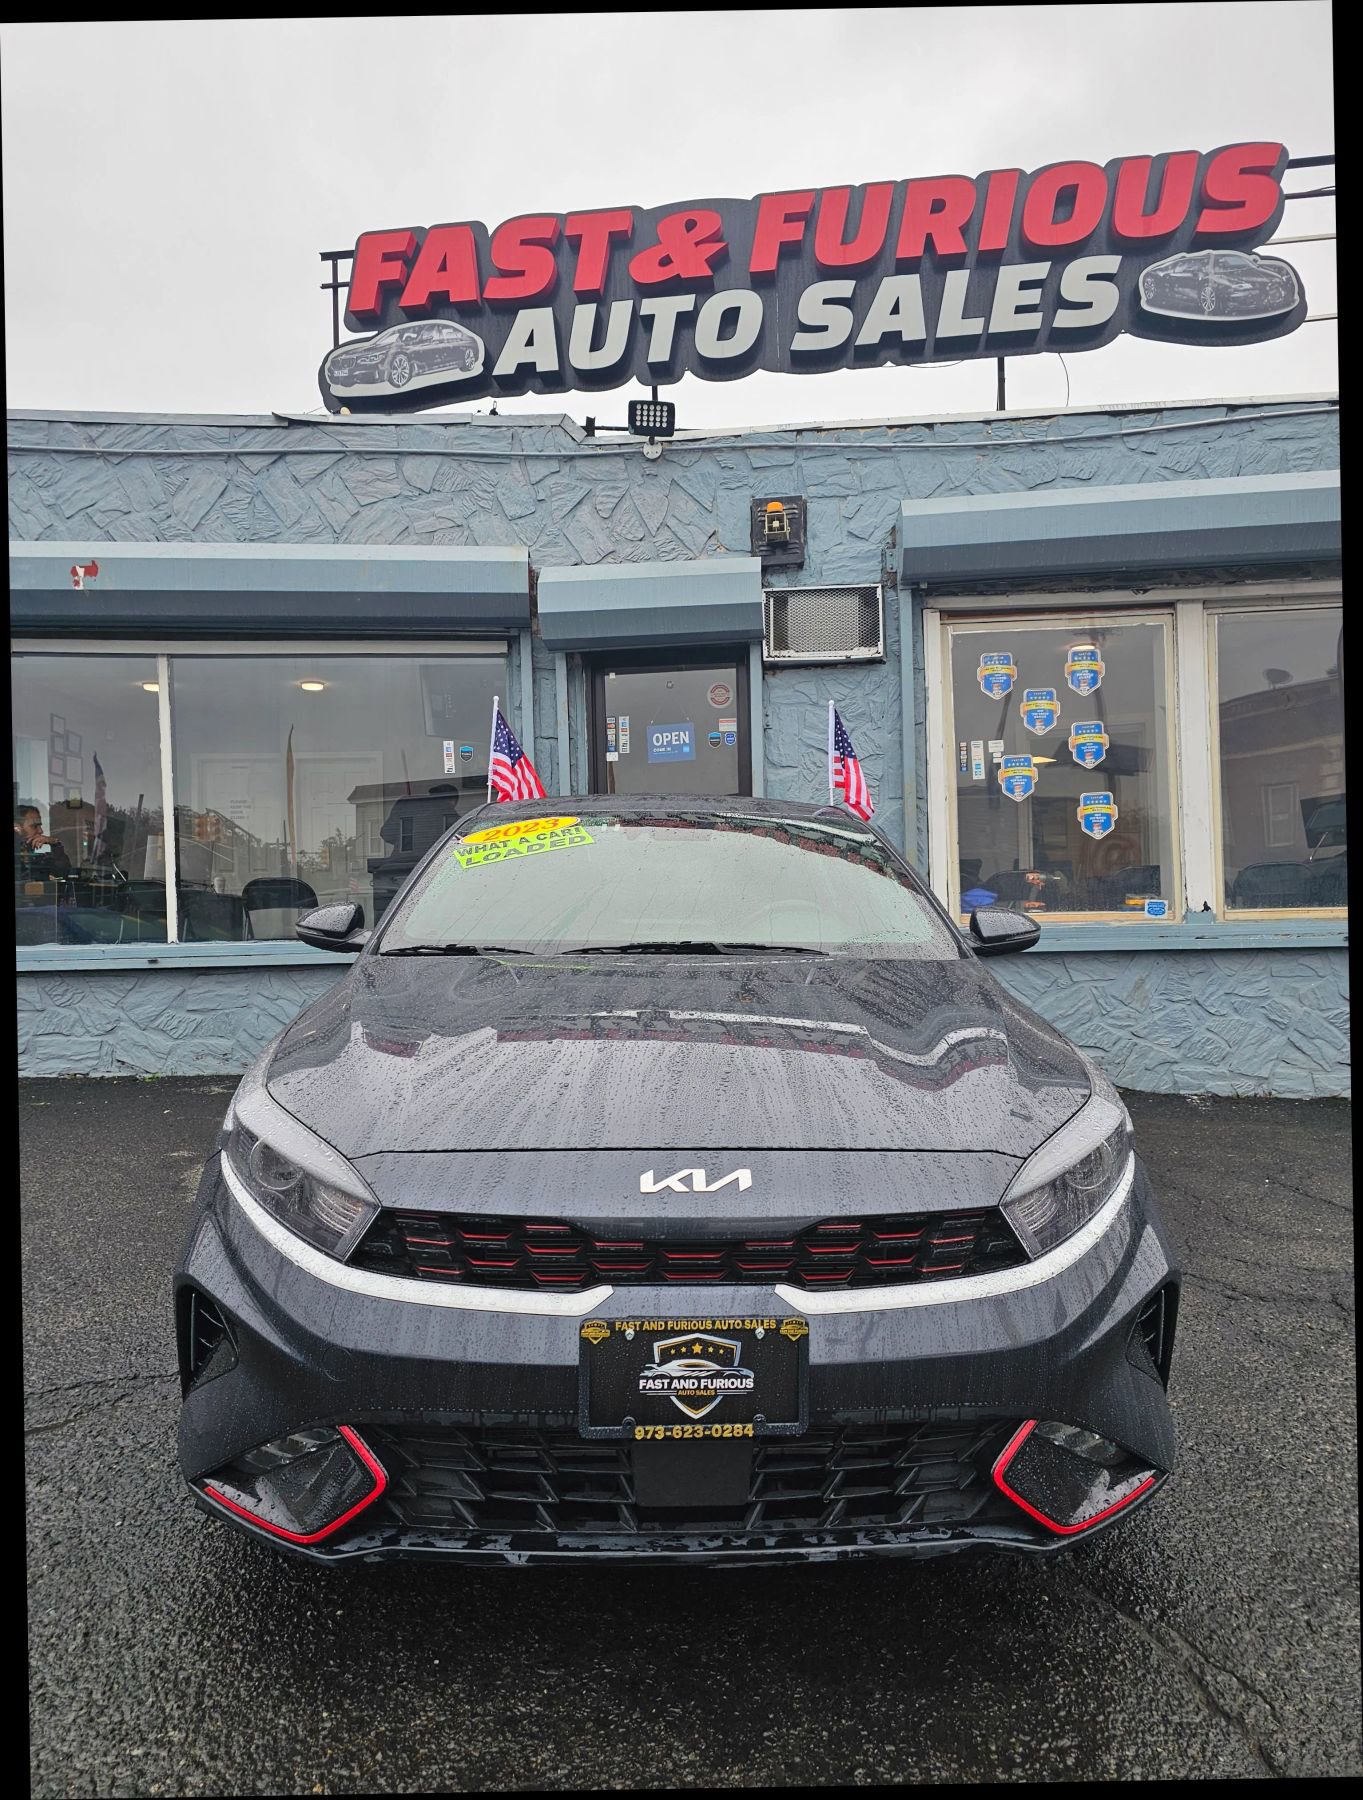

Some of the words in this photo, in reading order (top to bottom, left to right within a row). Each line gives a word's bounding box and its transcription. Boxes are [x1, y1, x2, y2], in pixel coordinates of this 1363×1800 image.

[349, 209, 634, 316] FAST
[629, 209, 728, 285] &
[750, 142, 1284, 275] FURIOUS
[492, 288, 764, 376] AUTO
[789, 254, 1123, 351] SALES
[652, 731, 690, 746] OPEN
[483, 818, 561, 842] 2023
[457, 840, 511, 857] WHAT
[519, 837, 530, 845] A
[465, 835, 587, 866] LOADED
[639, 1168, 753, 1193] KIA
[615, 1321, 641, 1331] FAST
[642, 1320, 665, 1331] AND
[667, 1320, 712, 1331] FURIOUS
[714, 1319, 742, 1330] AUTO
[744, 1319, 777, 1329] SALES
[639, 1379, 670, 1389] FAST
[671, 1378, 698, 1389] AND
[700, 1378, 754, 1389] FURIOUS
[634, 1423, 755, 1440] 973-623-0284
